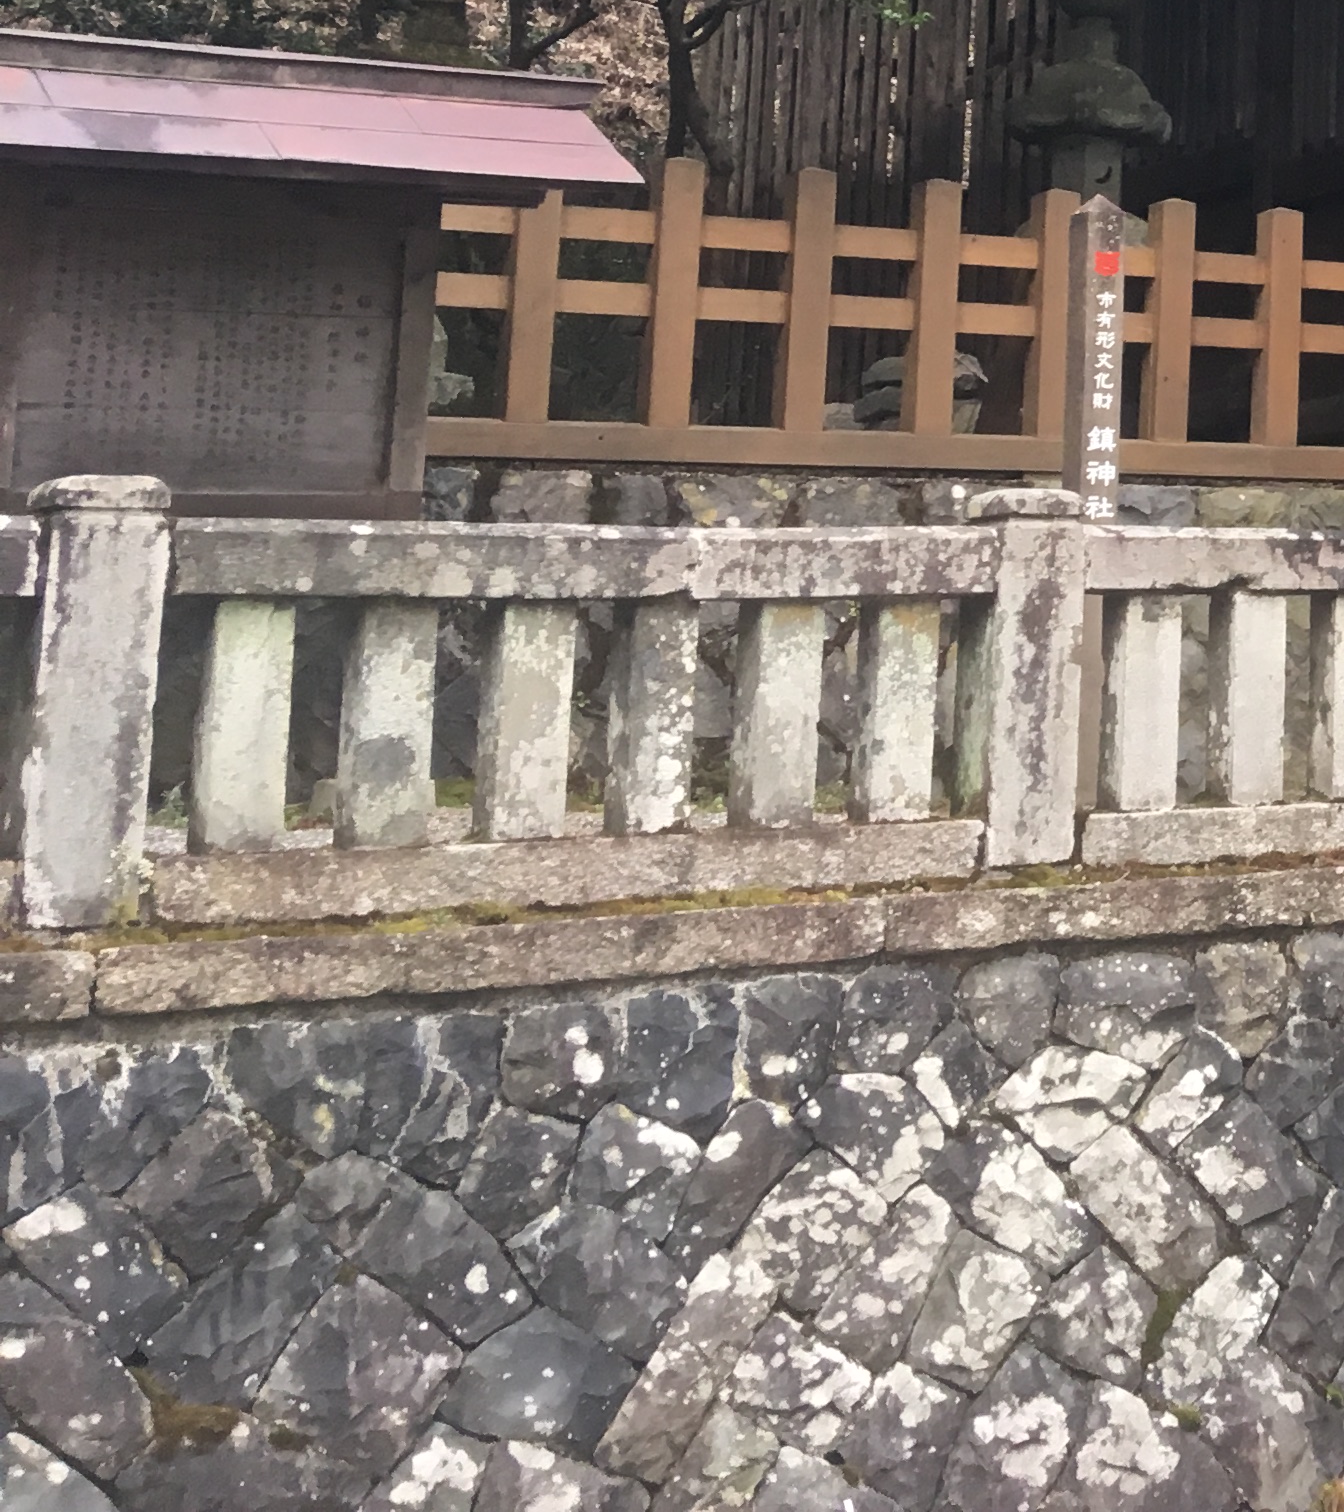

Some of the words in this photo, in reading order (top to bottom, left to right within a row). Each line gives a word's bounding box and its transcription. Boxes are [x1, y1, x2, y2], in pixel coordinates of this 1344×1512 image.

[1093, 291, 1117, 410] 市有形文化財
[1085, 425, 1117, 520] 鎮神社
